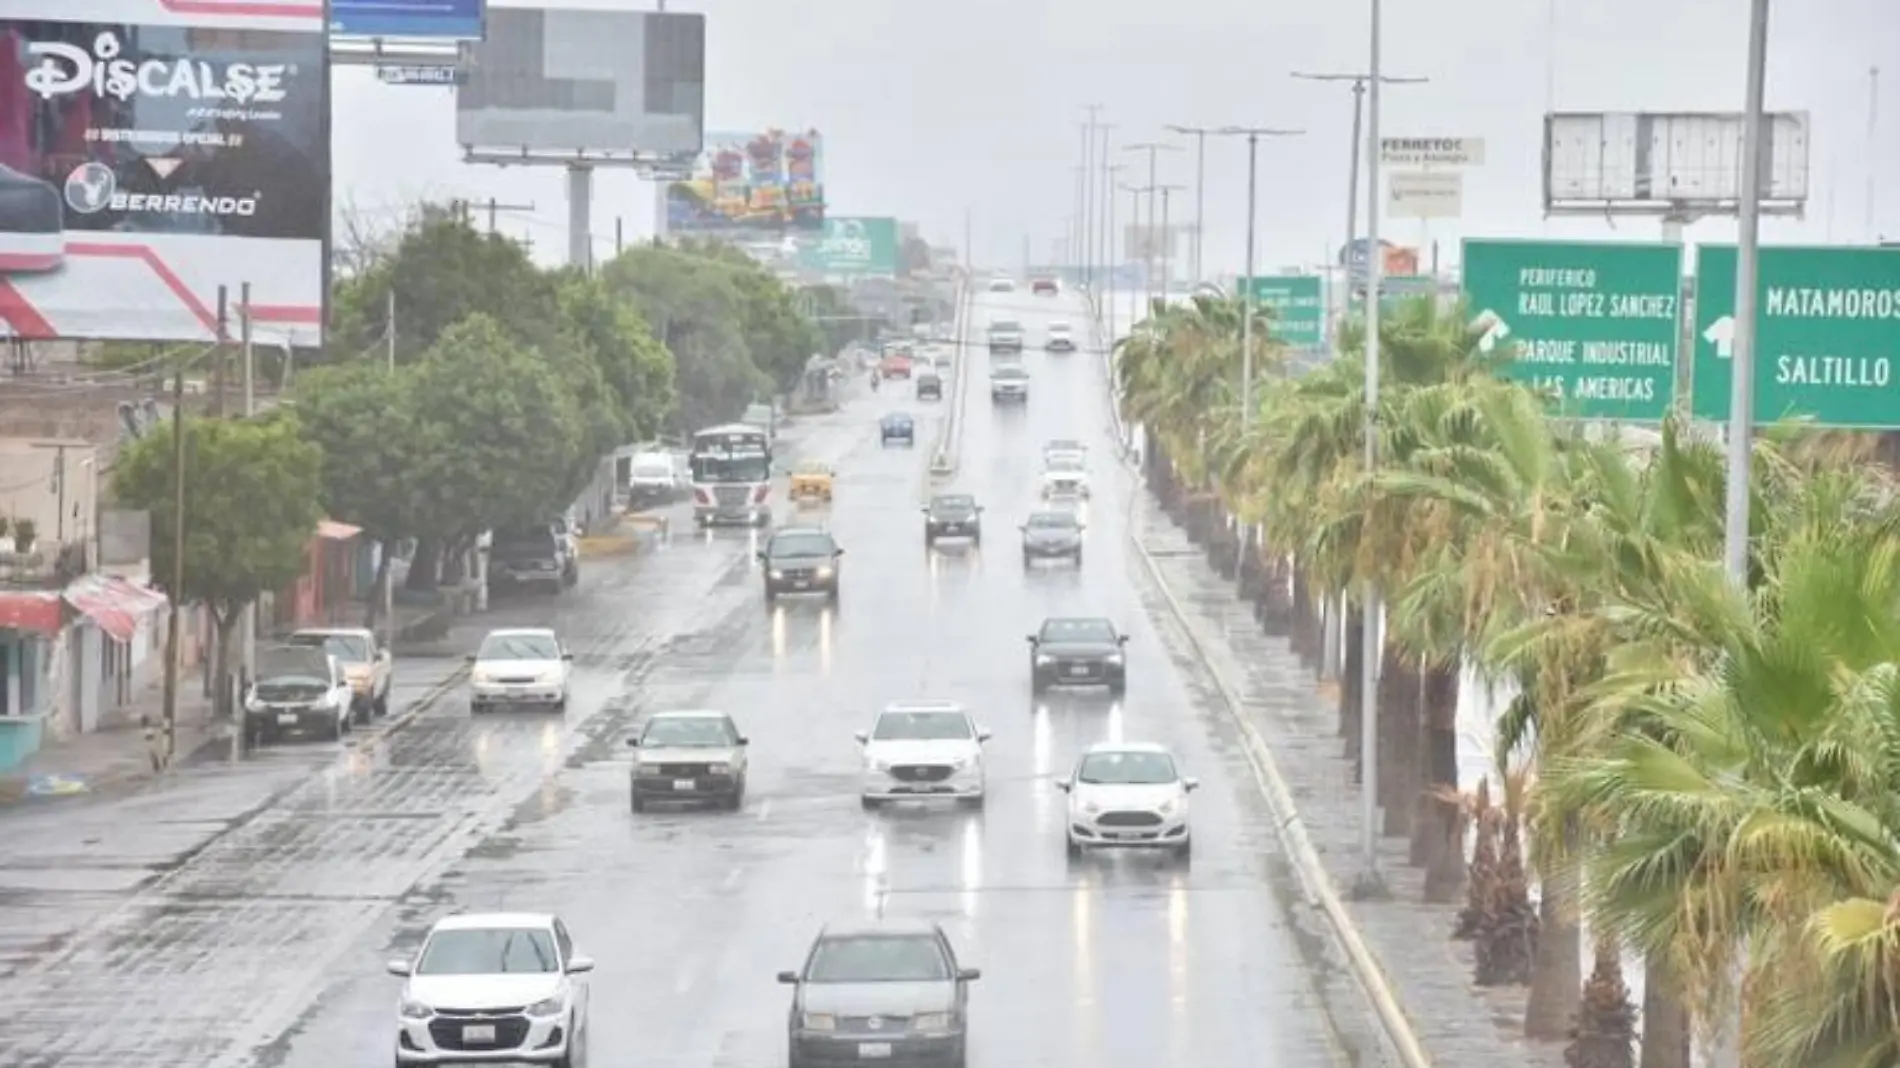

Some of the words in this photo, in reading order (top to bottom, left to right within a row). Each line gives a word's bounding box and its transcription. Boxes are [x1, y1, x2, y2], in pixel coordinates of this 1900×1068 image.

[109, 193, 256, 216] BERRENDO
[1520, 268, 1597, 288] PERIFERICO
[1518, 292, 1556, 316] RAUL
[1559, 292, 1605, 318] LOPEZ
[1609, 294, 1676, 319] SANCHEZ
[1515, 339, 1576, 364] PARQUE
[1582, 341, 1672, 366] INDUSTRIAL
[1775, 355, 1890, 387] SALTILLO
[1574, 376, 1656, 401] AMERICAS
